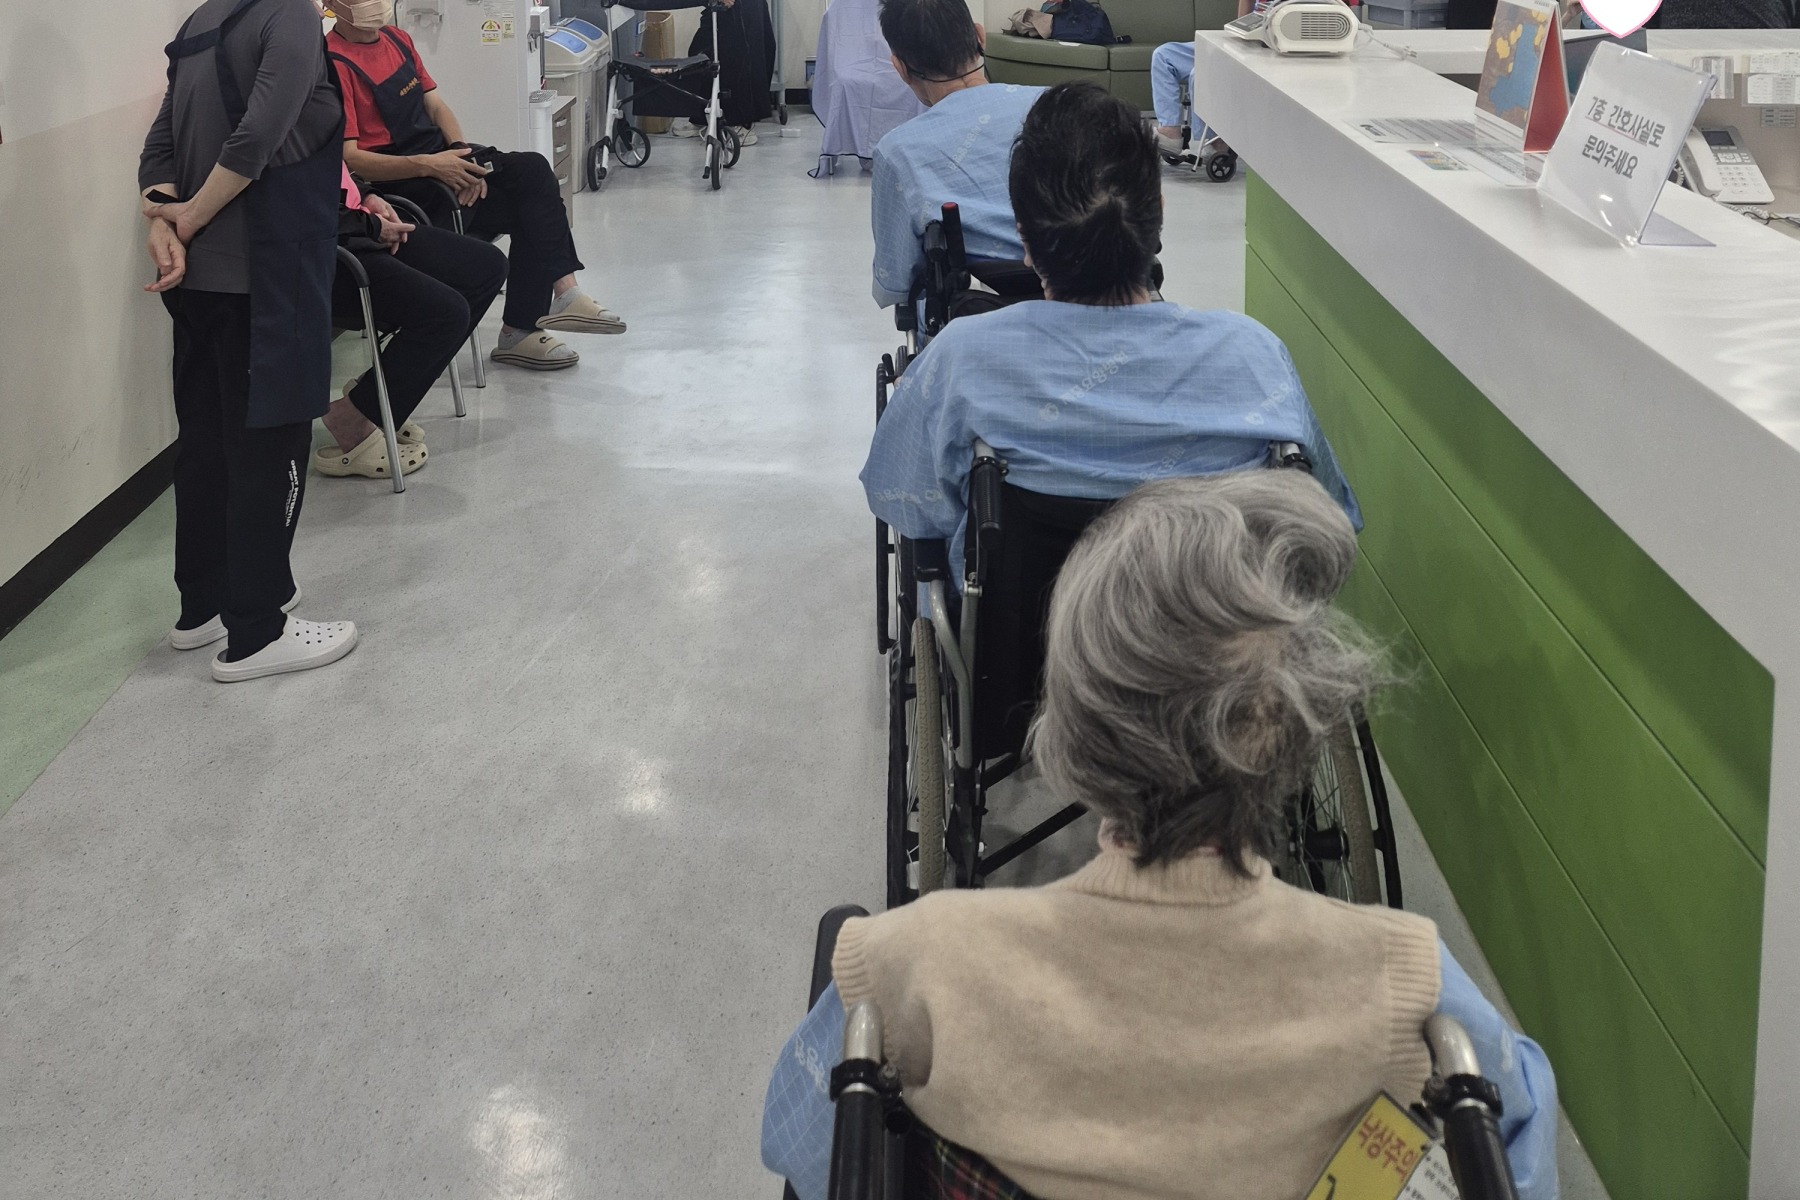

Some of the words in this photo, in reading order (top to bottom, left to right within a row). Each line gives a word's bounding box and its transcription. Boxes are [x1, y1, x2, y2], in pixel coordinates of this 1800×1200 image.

[1587, 96, 1607, 122] 7층
[1609, 105, 1665, 147] 간호사실로
[1582, 135, 1638, 179] 문의주세요
